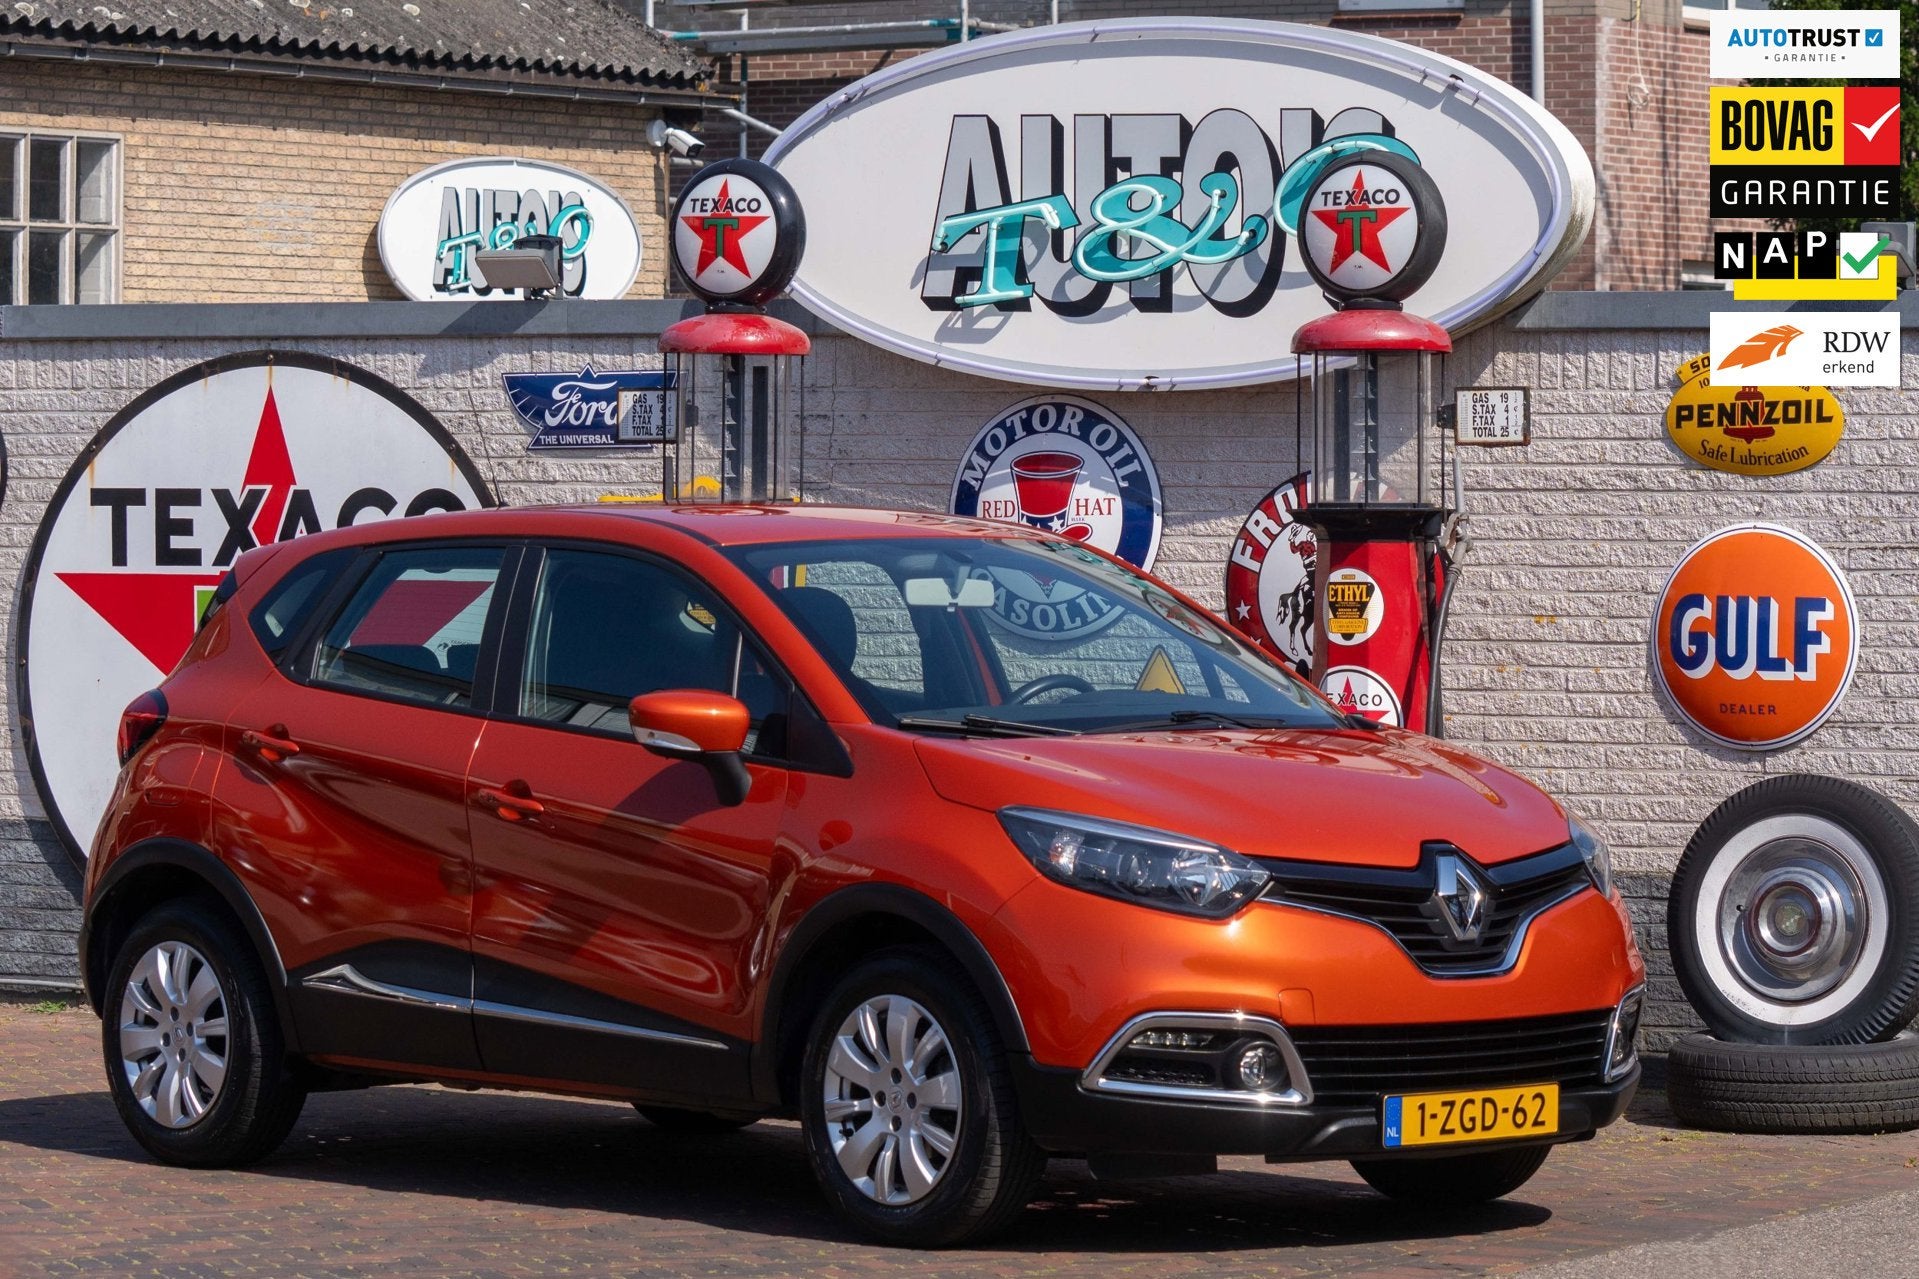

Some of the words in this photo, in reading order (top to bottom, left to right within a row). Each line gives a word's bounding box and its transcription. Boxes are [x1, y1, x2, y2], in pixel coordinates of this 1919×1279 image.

[1320, 188, 1401, 207] TEXACO
[690, 197, 762, 213] TEXACO
[632, 393, 648, 404] GAS
[1472, 393, 1489, 403] GAS
[1500, 393, 1508, 403] 19
[632, 404, 653, 415] S.TAX
[1472, 404, 1496, 414] S.TAX
[1504, 404, 1508, 414] 4
[1675, 399, 1834, 430] PENNZOIL
[632, 415, 652, 425] F.TAX
[1473, 416, 1495, 426] F.TAX
[632, 425, 653, 437] TOTAL
[1473, 427, 1497, 437] TOTAL
[1500, 427, 1509, 437] 25
[539, 435, 557, 444] THE
[559, 435, 614, 444] UNIVERSAL
[962, 404, 1084, 492] MOTOR
[1089, 423, 1142, 488] OIL
[1698, 440, 1728, 462] Safe
[1730, 445, 1809, 467] Lubrication
[982, 500, 1016, 518] RED
[1075, 498, 1116, 516] HAT
[1328, 584, 1370, 602] ETHYL
[1670, 593, 1835, 682] GULF
[1719, 704, 1777, 716] DEALER
[1417, 1092, 1546, 1137] 1-ZGD-62
[1386, 1127, 1399, 1138] NL
